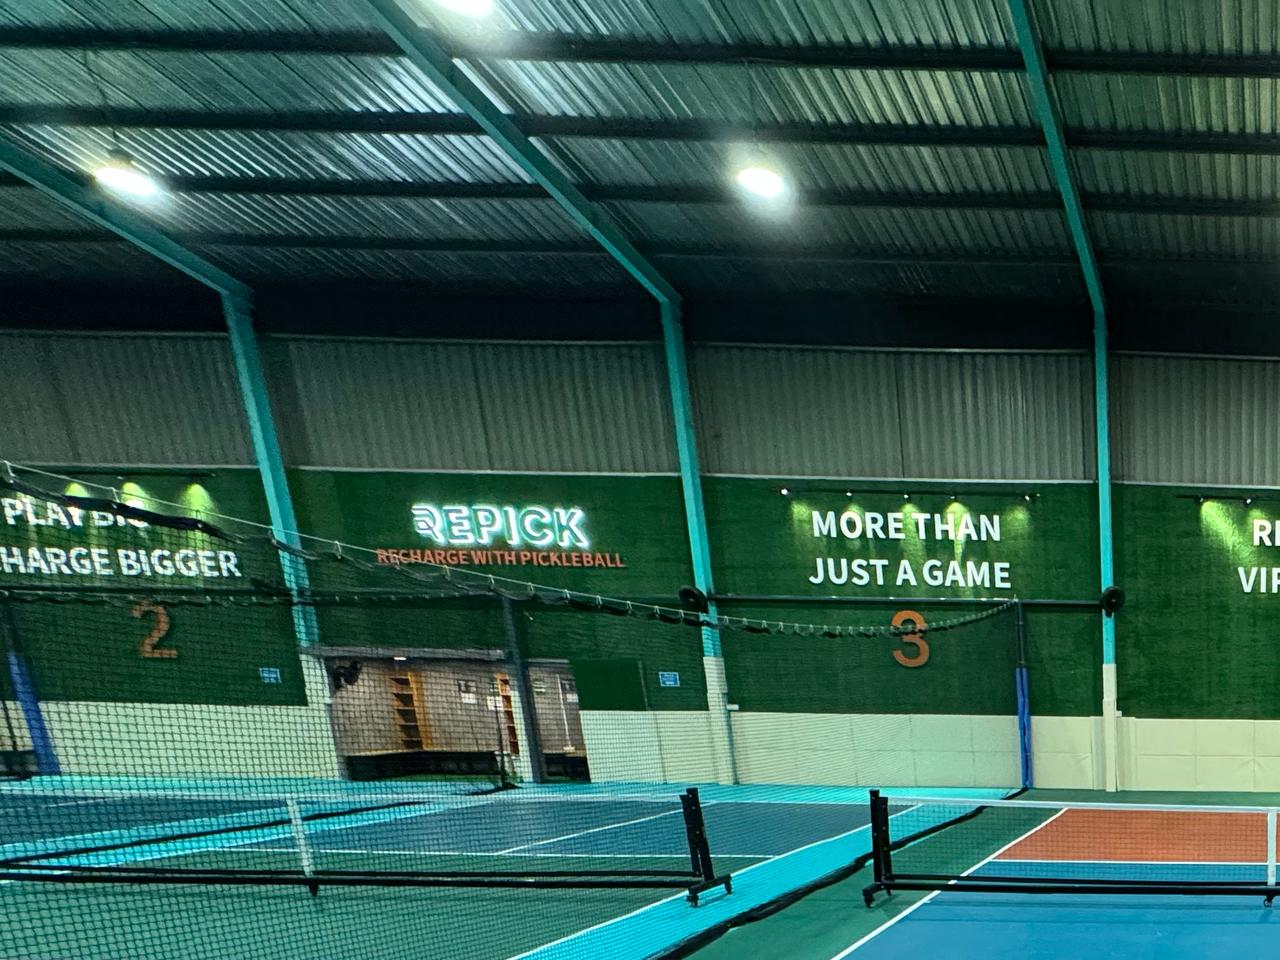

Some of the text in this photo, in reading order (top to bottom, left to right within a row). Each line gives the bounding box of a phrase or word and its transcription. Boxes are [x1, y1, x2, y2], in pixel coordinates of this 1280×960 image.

[1, 495, 86, 530] PLAY
[411, 504, 589, 546] REPICK
[811, 510, 1001, 542] MORE THAN
[0, 546, 243, 578] HARGE BIGGER
[376, 549, 626, 568] RECHARGE WITH PICKLEBALL
[808, 557, 1012, 589] JUST A GAME
[129, 601, 179, 659] 2
[890, 609, 930, 668] 3
